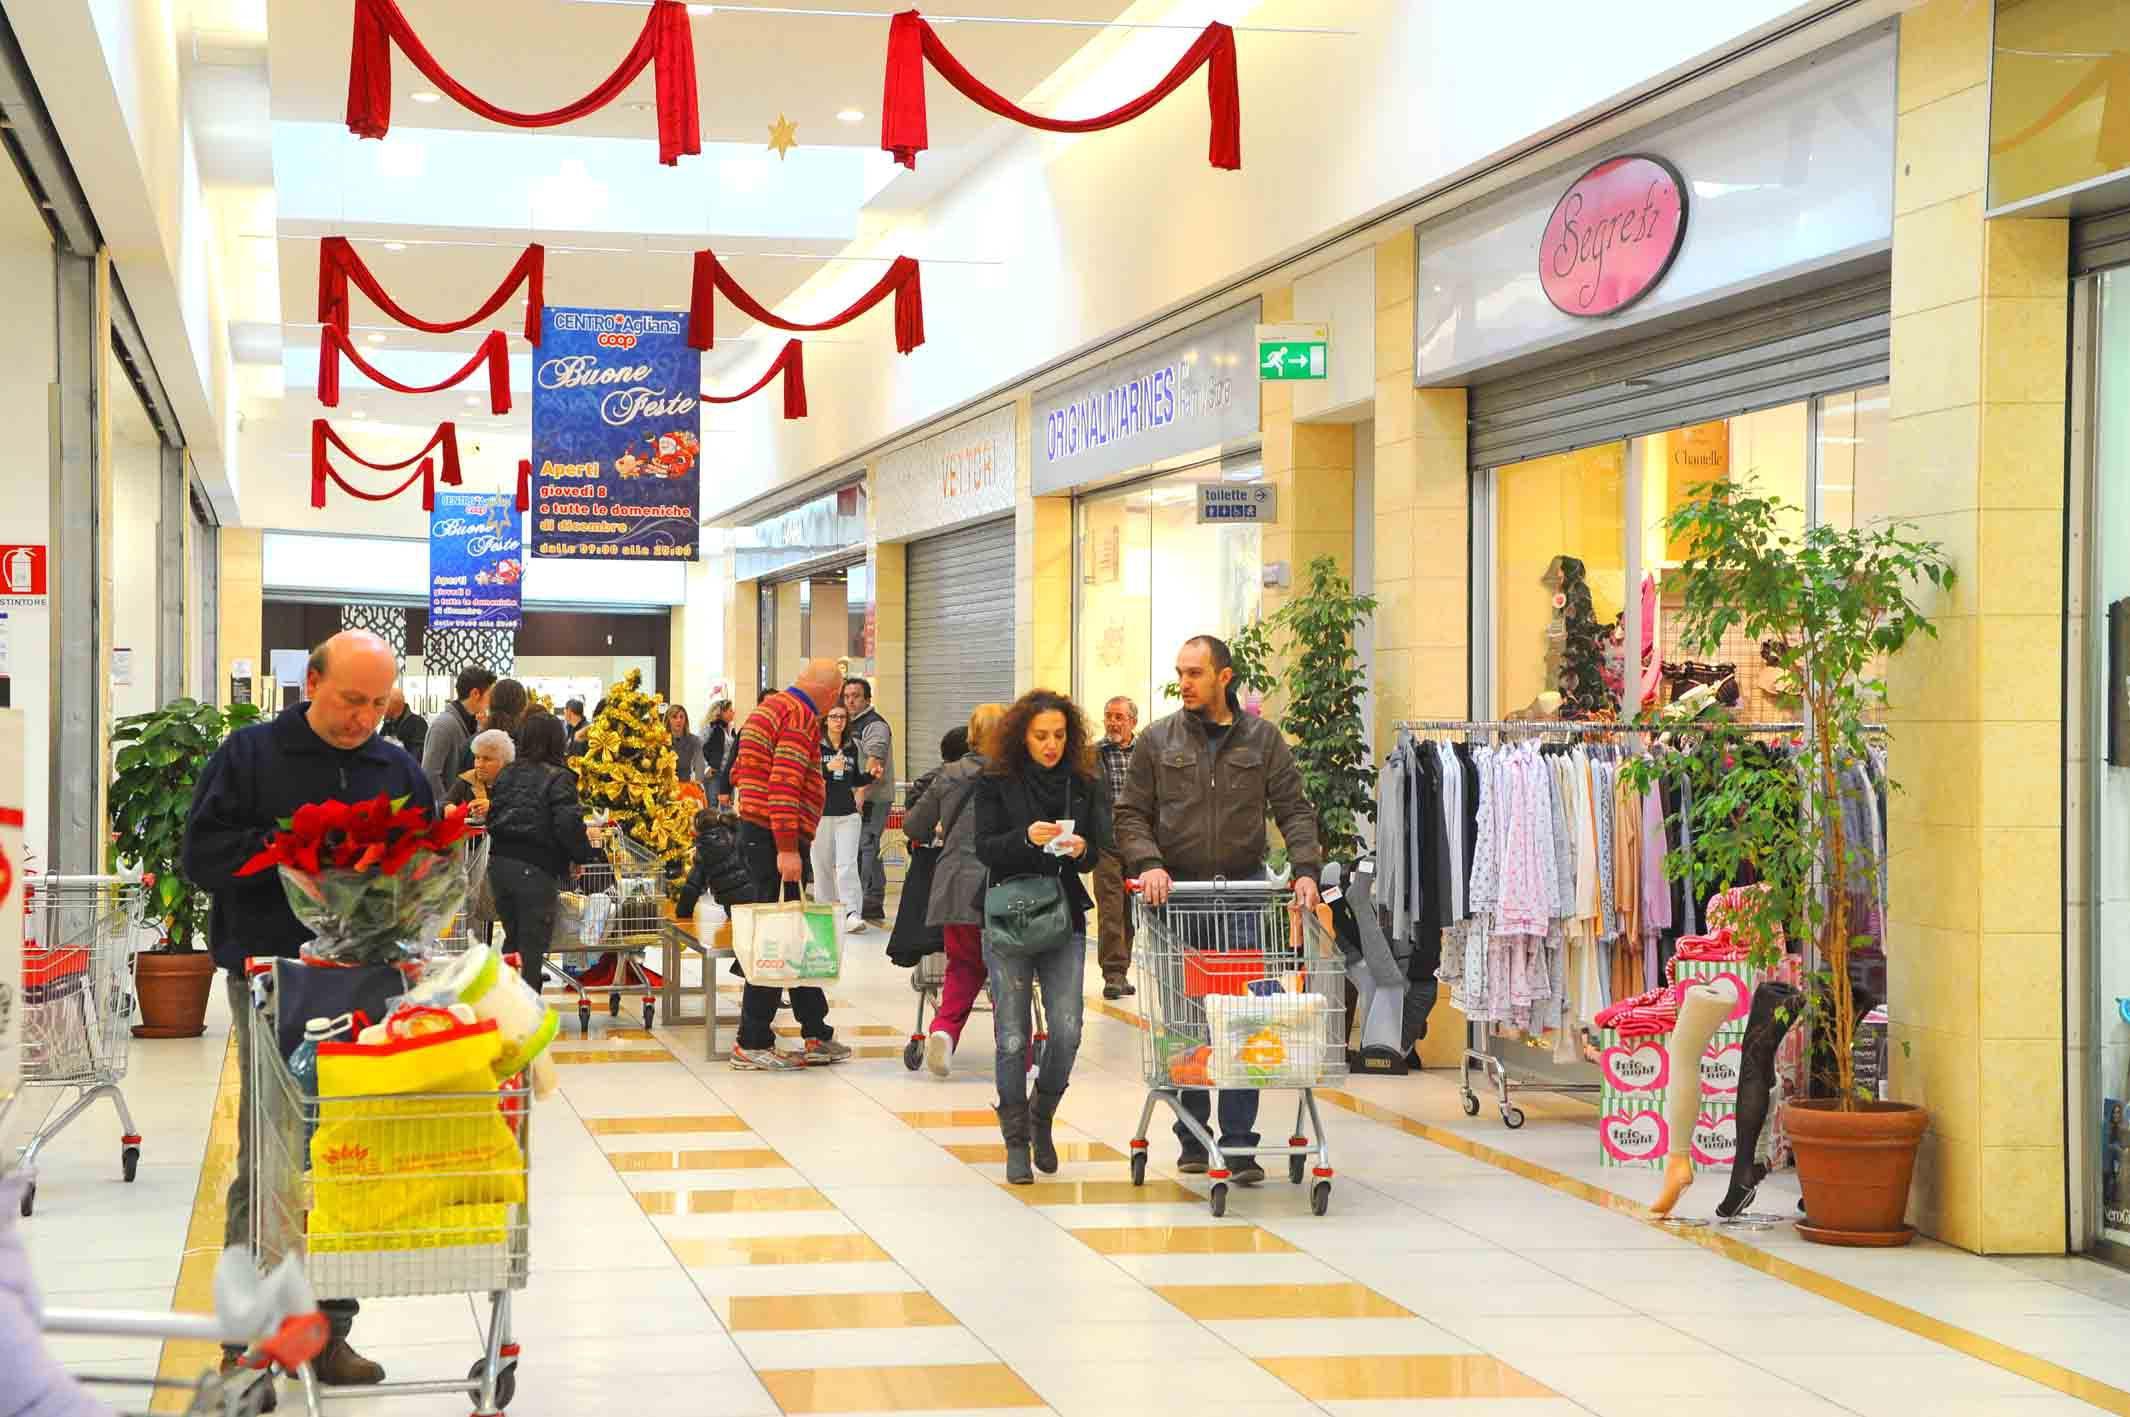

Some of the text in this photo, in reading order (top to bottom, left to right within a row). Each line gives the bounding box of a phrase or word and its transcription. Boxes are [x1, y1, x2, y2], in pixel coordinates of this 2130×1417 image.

[621, 315, 680, 336] Agliana
[598, 332, 637, 350] coop
[538, 356, 652, 389] Buone
[601, 387, 697, 425] Feste
[540, 461, 600, 479] Aperti
[597, 484, 608, 497] 8
[1205, 489, 1248, 501] toilette
[540, 502, 692, 517] e tutte le domeniche
[540, 519, 628, 533] di dicembre
[467, 535, 521, 557] Feste
[540, 543, 576, 555] dalle
[622, 545, 650, 556] alle
